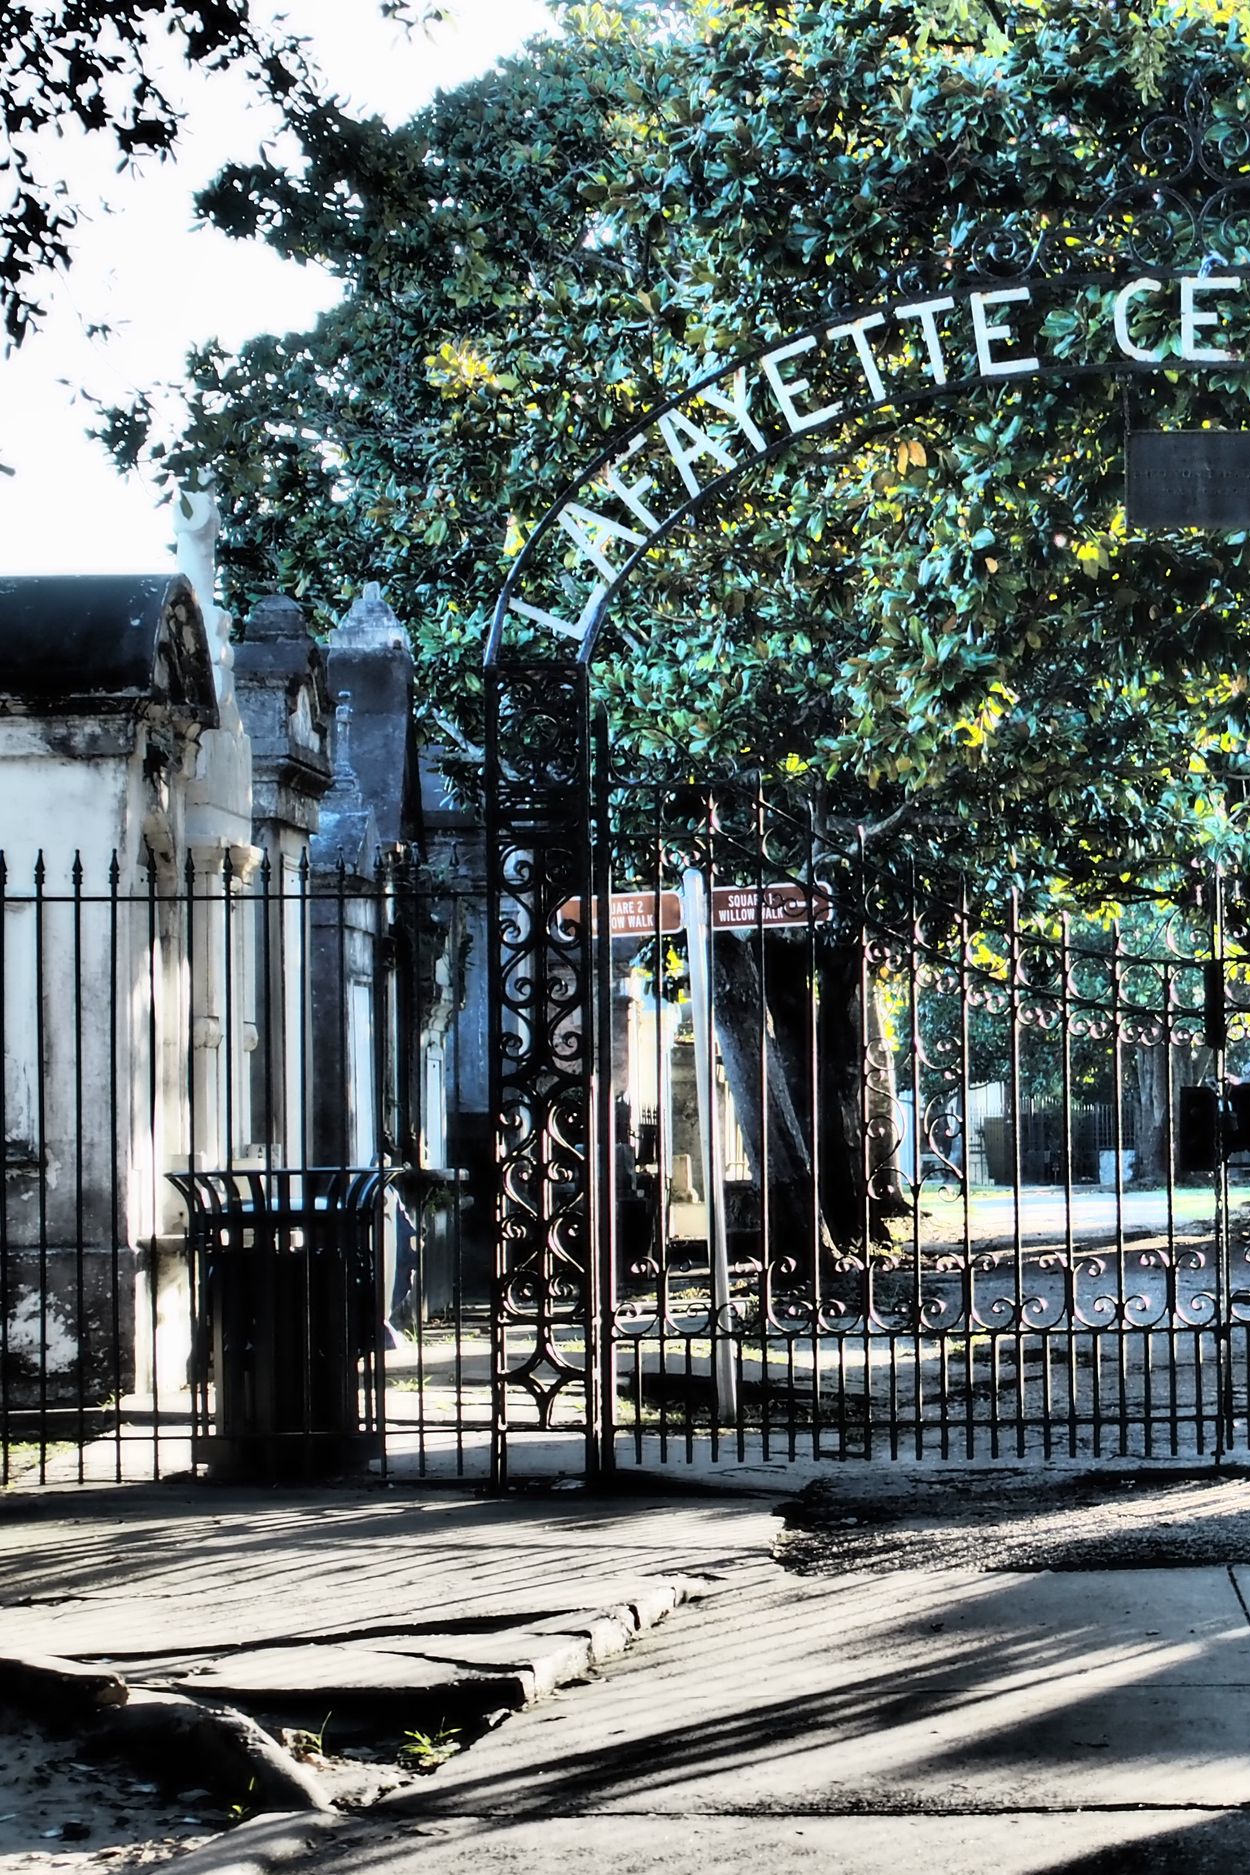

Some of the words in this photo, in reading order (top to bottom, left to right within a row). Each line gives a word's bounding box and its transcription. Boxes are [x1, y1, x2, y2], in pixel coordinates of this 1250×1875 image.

[508, 287, 1040, 641] LAFAYETTE
[637, 900, 644, 913] 2
[627, 914, 654, 928] WALK
[718, 908, 755, 922] WILLOW
